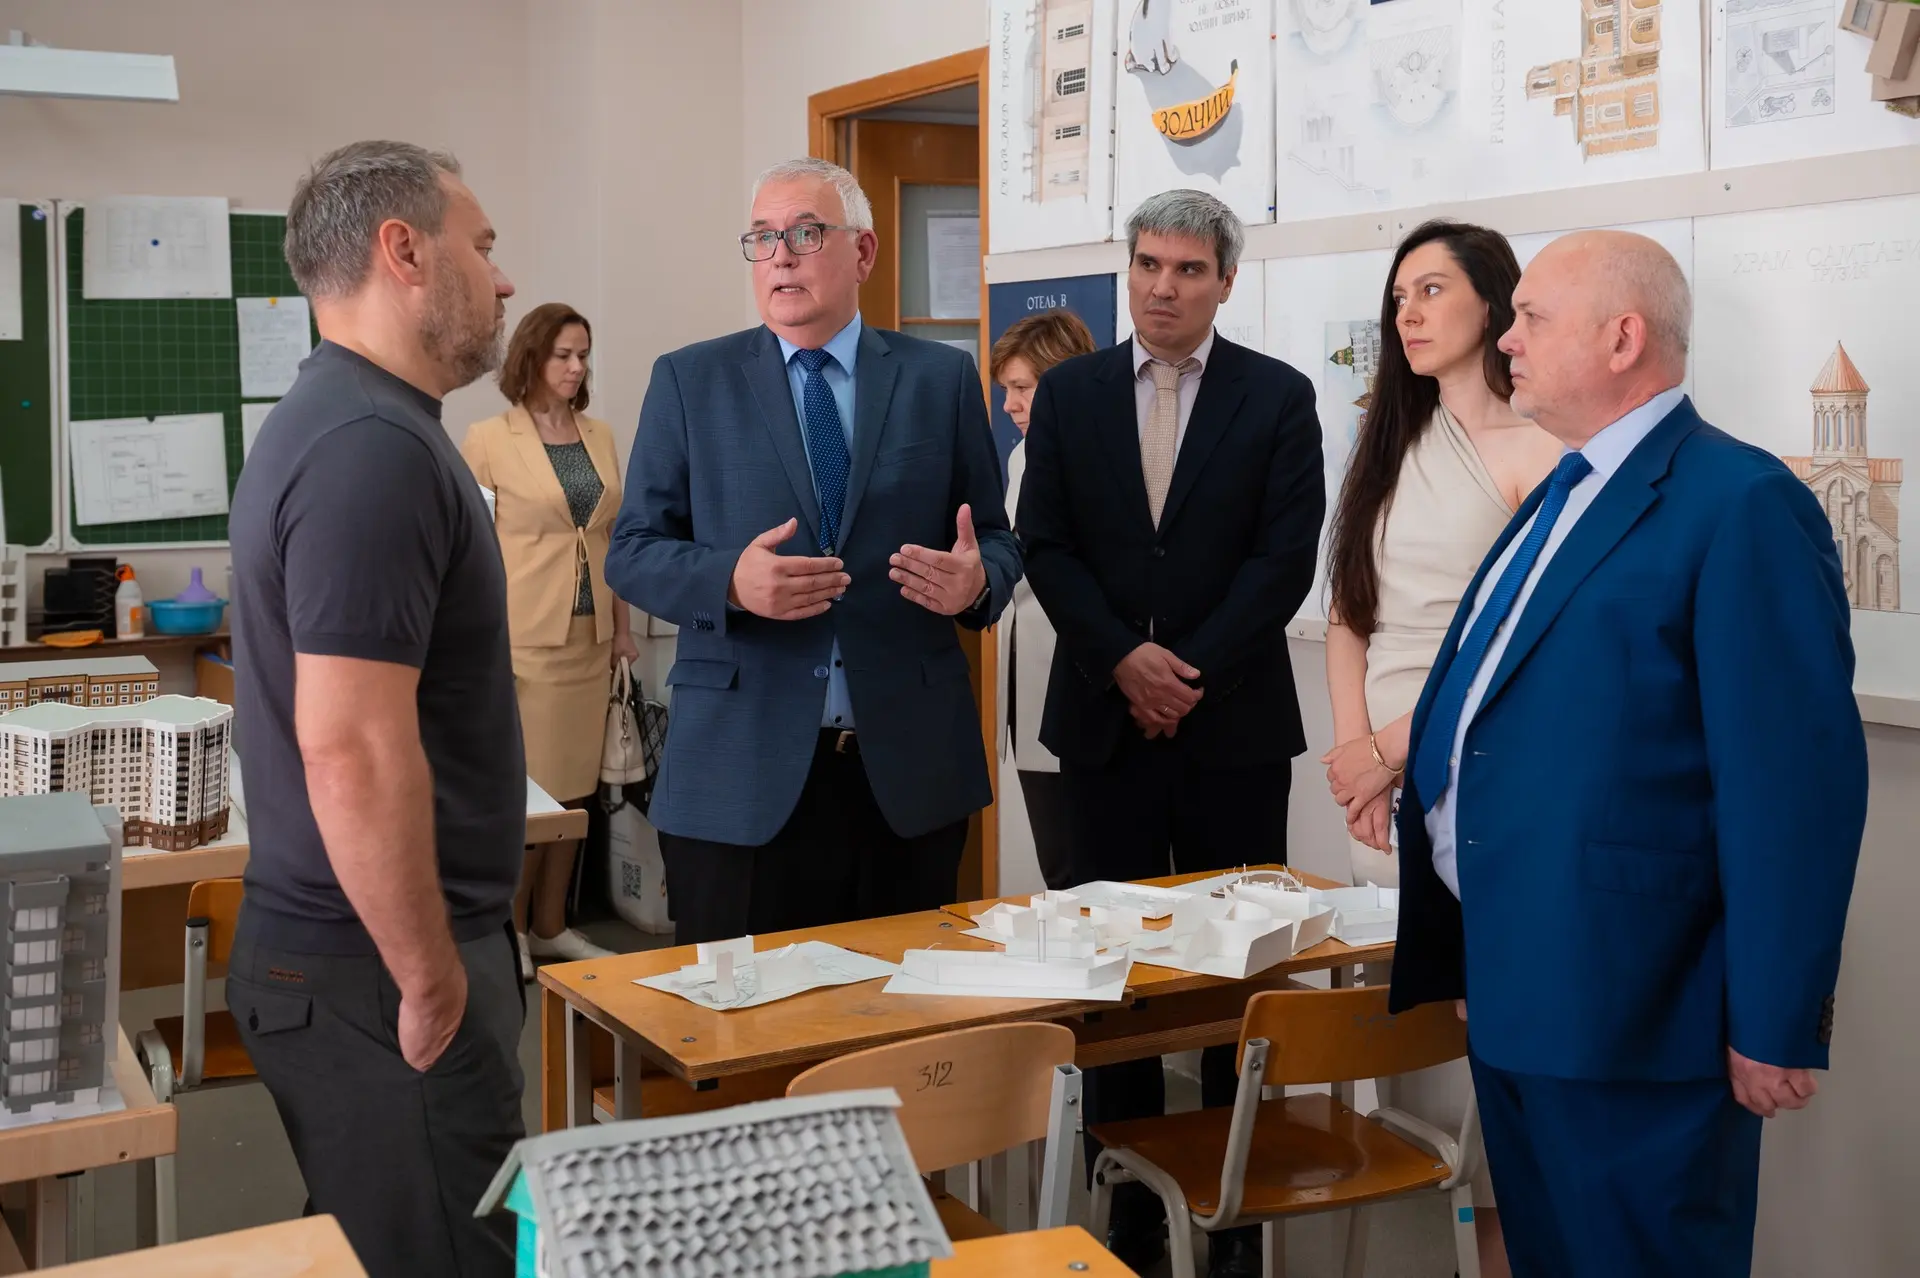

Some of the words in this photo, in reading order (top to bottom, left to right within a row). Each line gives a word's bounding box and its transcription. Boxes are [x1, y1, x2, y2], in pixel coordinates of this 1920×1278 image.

[1490, 39, 1506, 146] PRINCESS
[1732, 249, 1795, 275] ХРАМ
[1026, 294, 1057, 311] ОТЕЛЬ
[1060, 293, 1067, 308] В
[916, 1060, 954, 1092] 312
